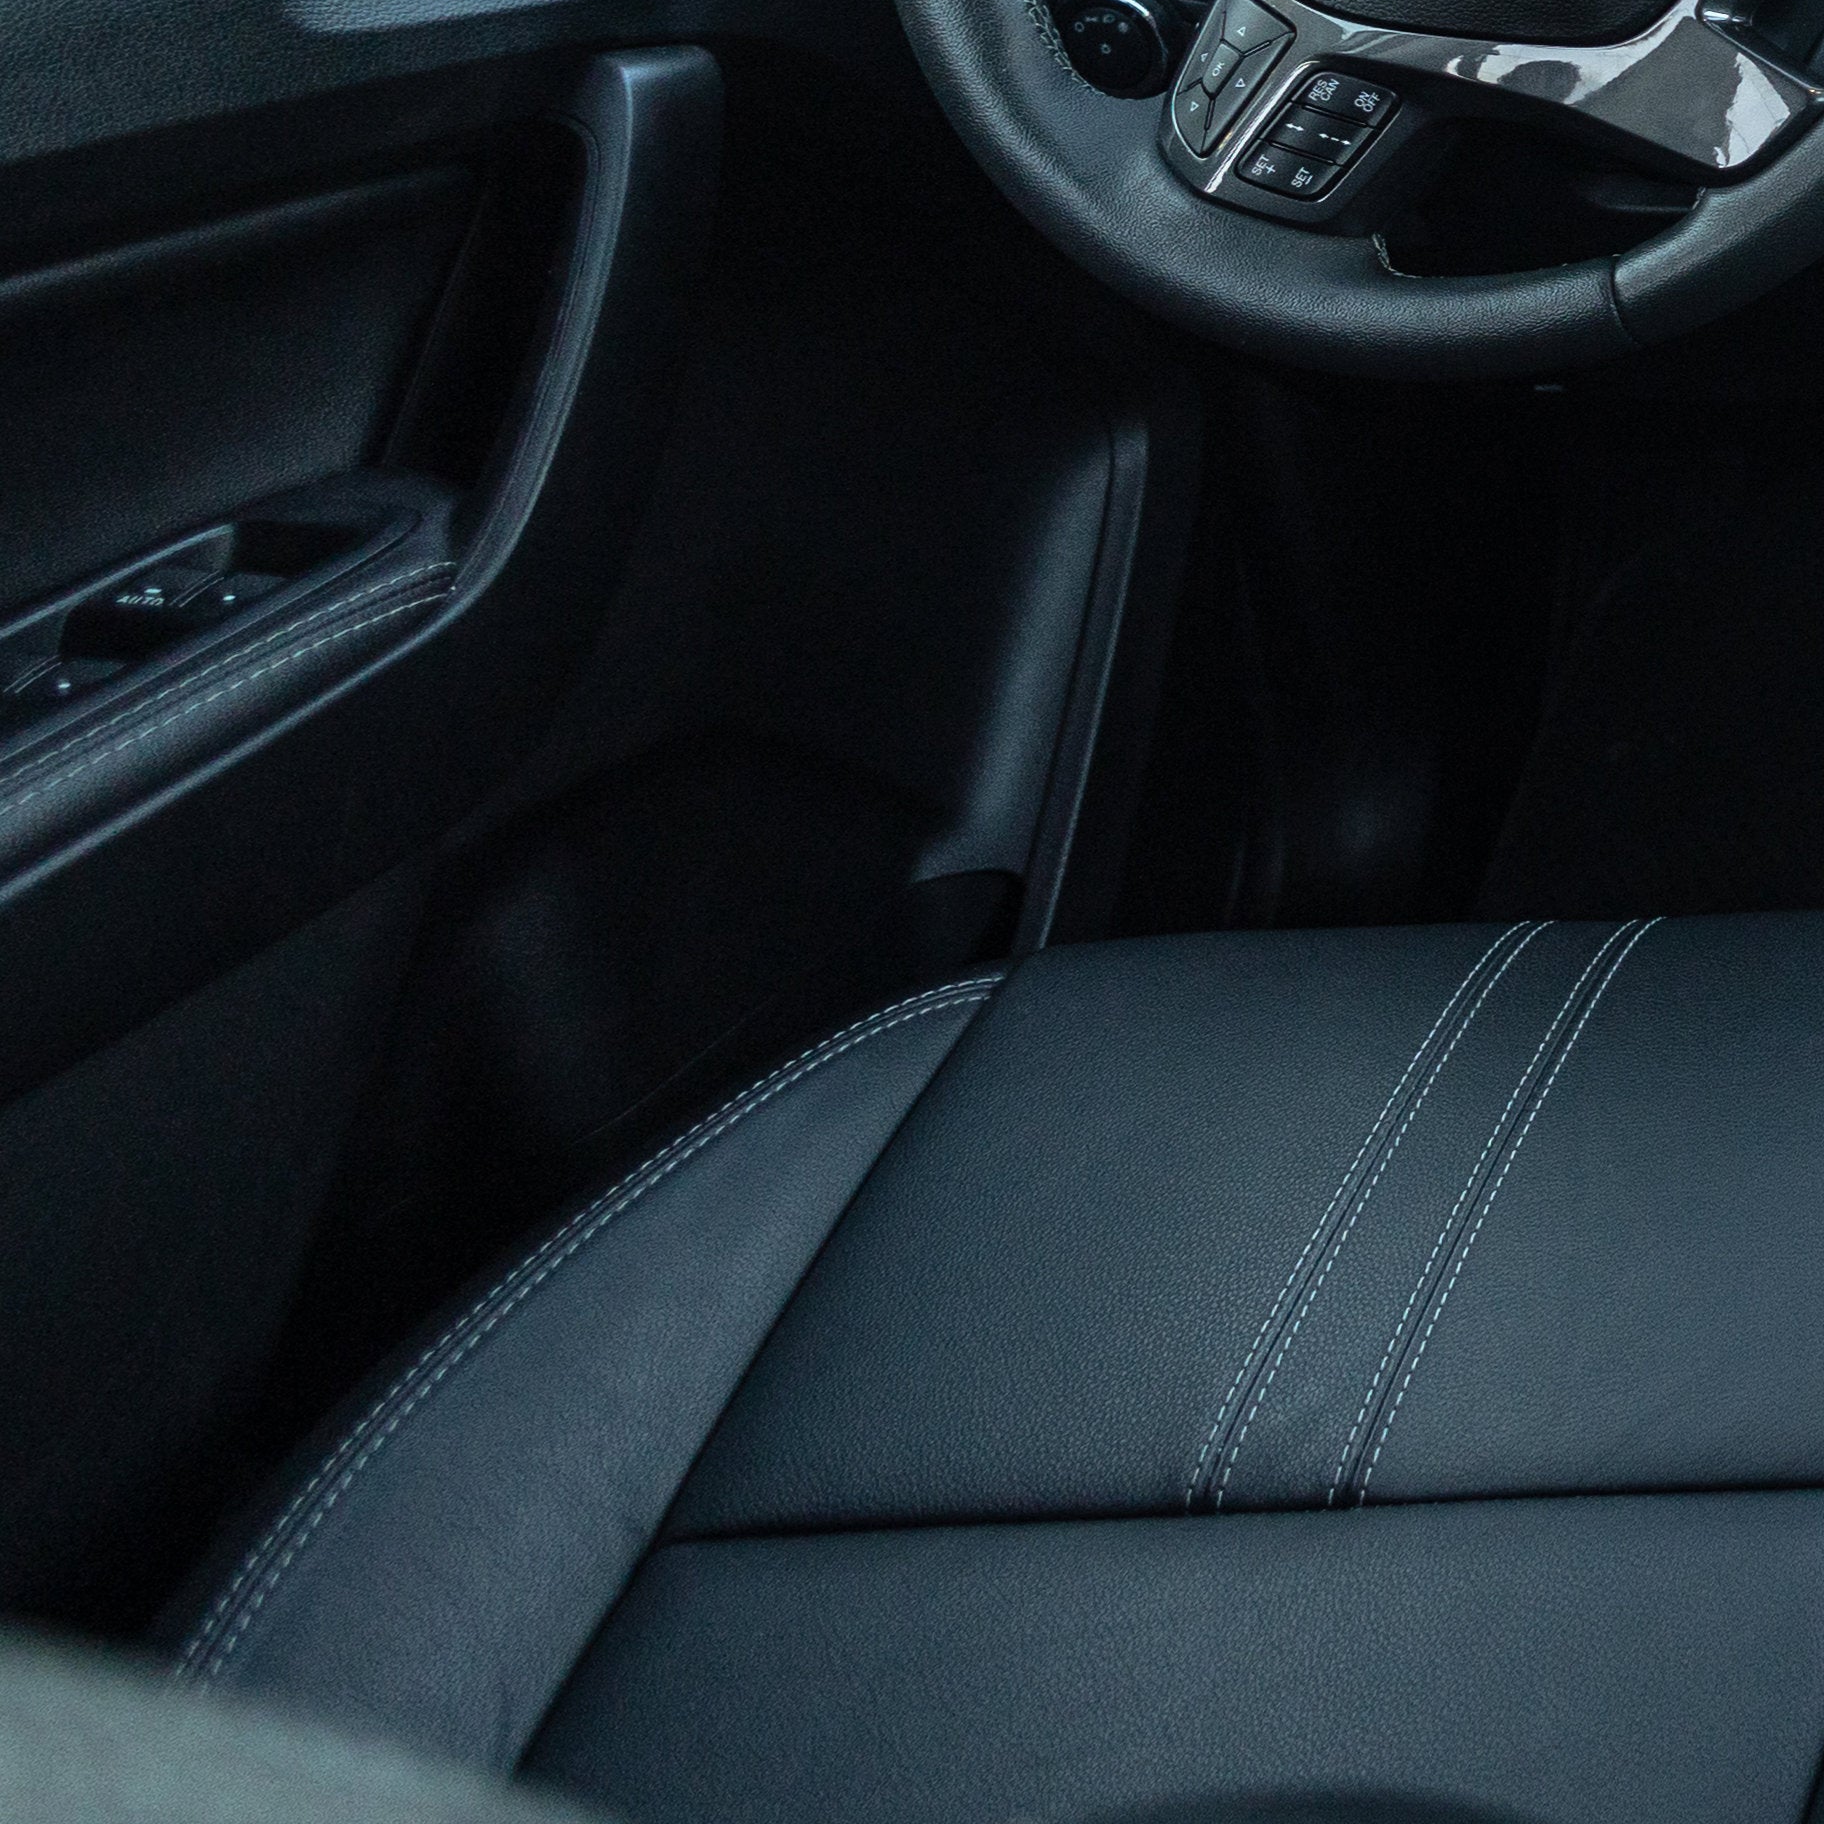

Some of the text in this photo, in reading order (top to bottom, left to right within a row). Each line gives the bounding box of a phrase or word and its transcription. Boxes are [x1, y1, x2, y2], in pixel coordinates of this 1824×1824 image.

[1211, 61, 1225, 77] OK
[1308, 79, 1328, 102] RES
[1320, 78, 1340, 102] CAN
[1354, 91, 1370, 108] ON
[1362, 91, 1381, 113] OFF
[1251, 153, 1269, 176] SET
[1291, 166, 1310, 188] SET
